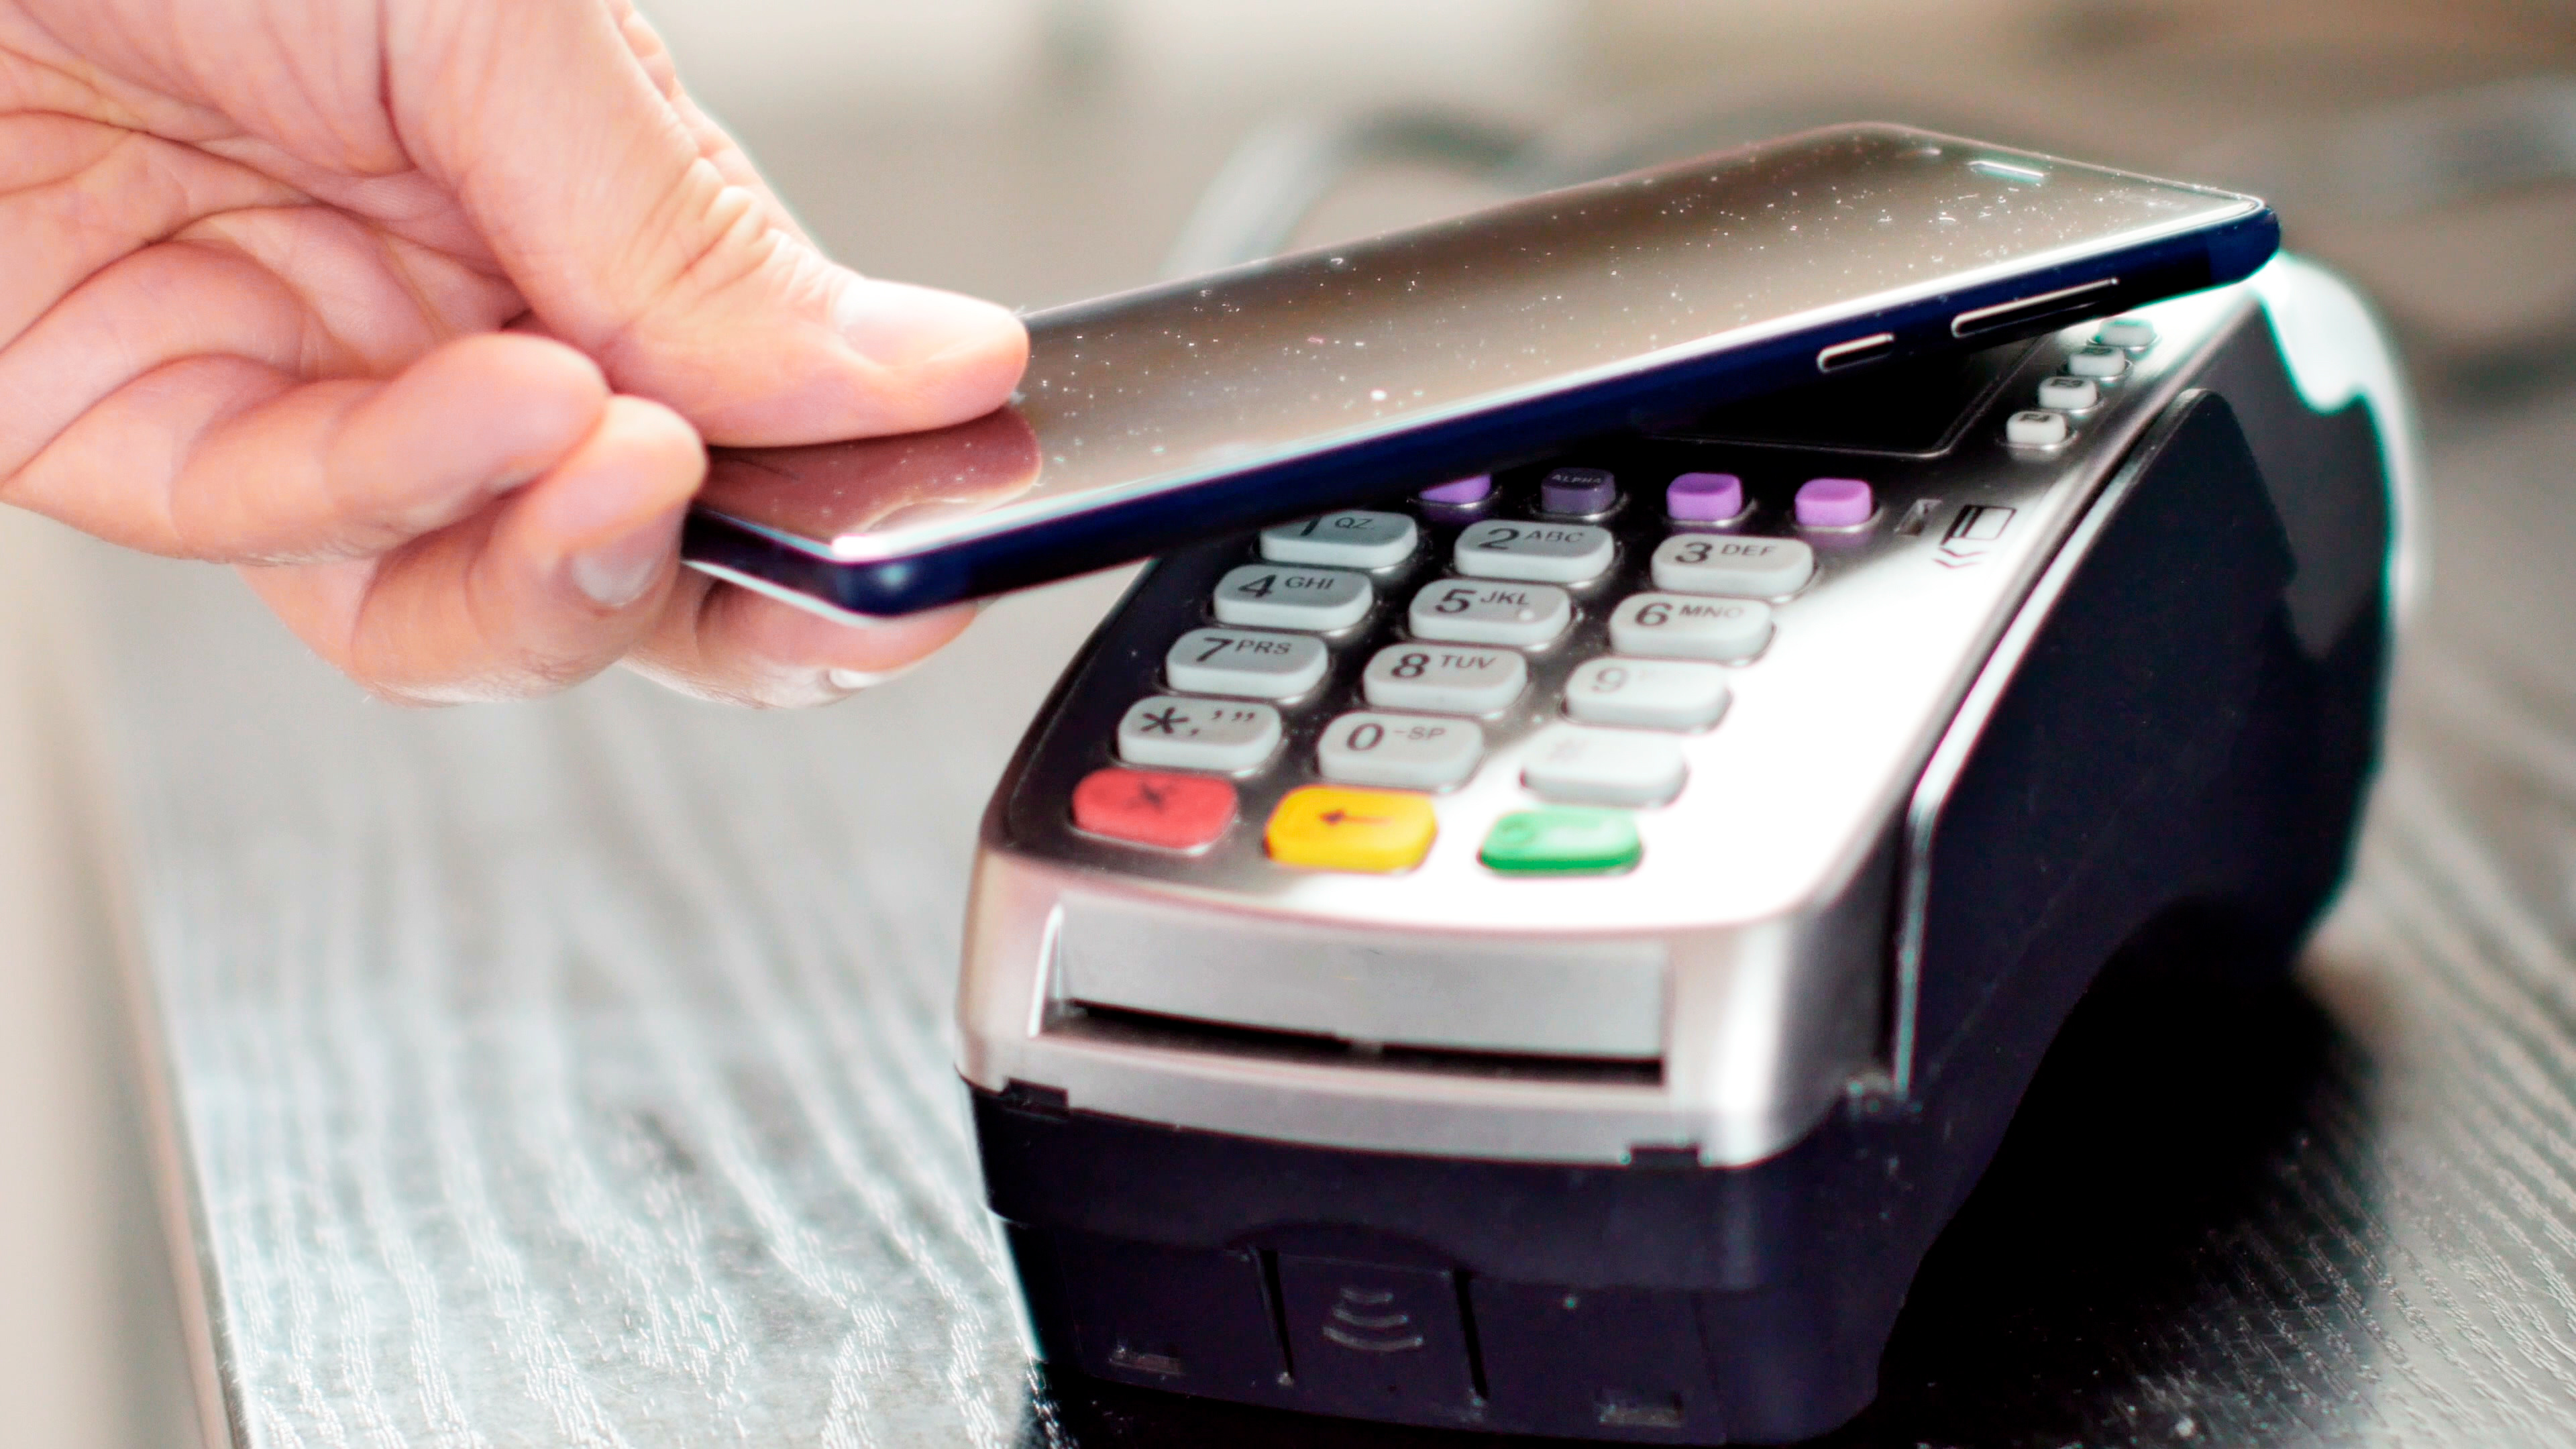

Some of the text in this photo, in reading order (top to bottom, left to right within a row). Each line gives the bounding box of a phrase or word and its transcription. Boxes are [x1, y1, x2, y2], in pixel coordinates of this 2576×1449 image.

[1551, 474, 1602, 484] ALPHA
[1300, 516, 1322, 537] 1
[1477, 527, 1585, 550] 2 ABC
[1674, 541, 1776, 564] 3 DEF
[1238, 574, 1335, 598] 4 GHI
[1435, 588, 1530, 614] 5 JKL
[1634, 602, 1745, 627] 6 MNO
[1196, 636, 1292, 663] 7 PRS
[1391, 652, 1497, 679] 8 TUV
[1591, 667, 1630, 695] 9
